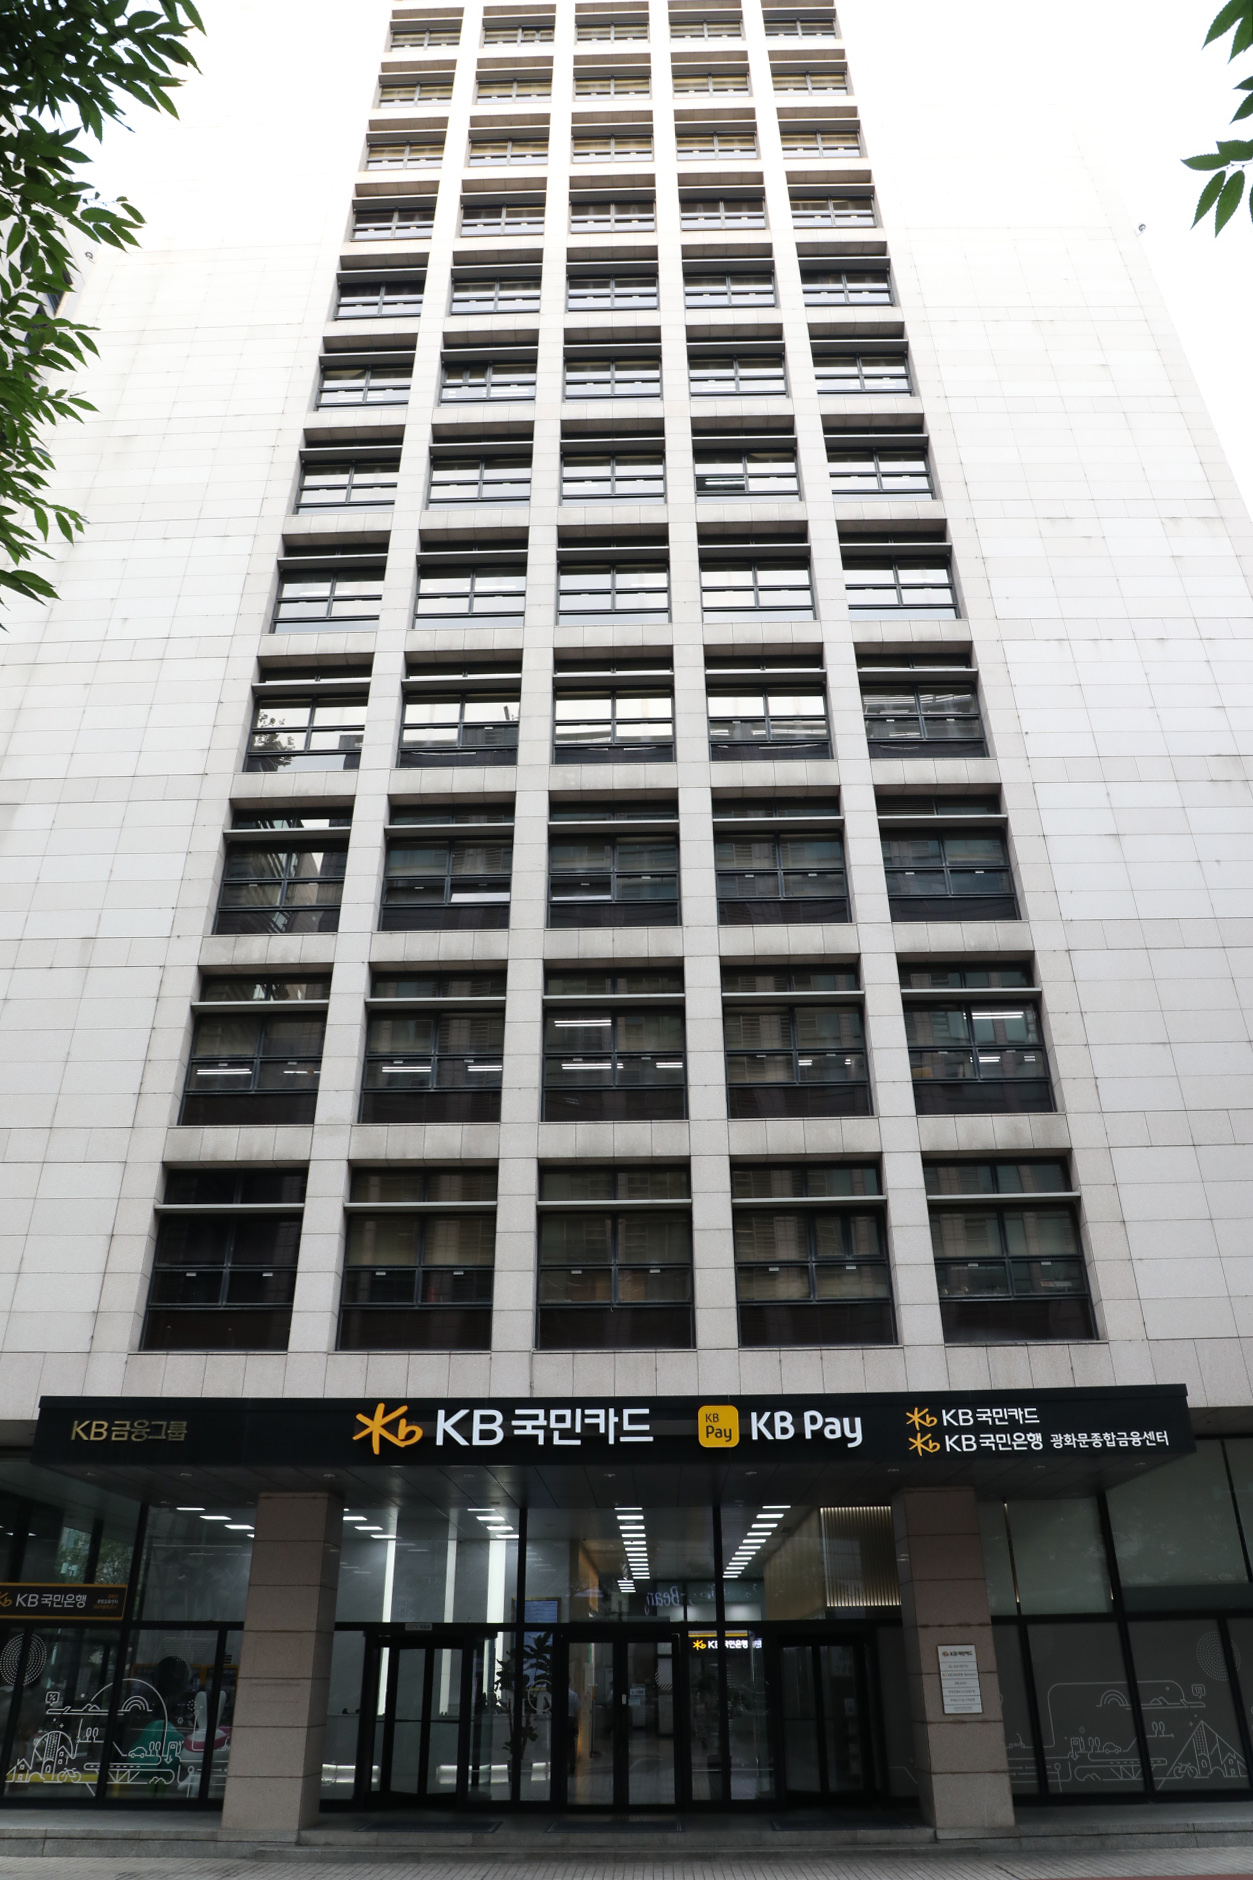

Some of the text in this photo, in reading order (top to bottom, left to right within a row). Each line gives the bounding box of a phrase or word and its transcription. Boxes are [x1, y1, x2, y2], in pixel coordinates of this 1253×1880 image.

[705, 1413, 719, 1423] KB
[706, 1425, 732, 1442] Pay
[751, 1410, 863, 1448] KB Pay
[1050, 1431, 1169, 1449] 광화문종합금융센터
